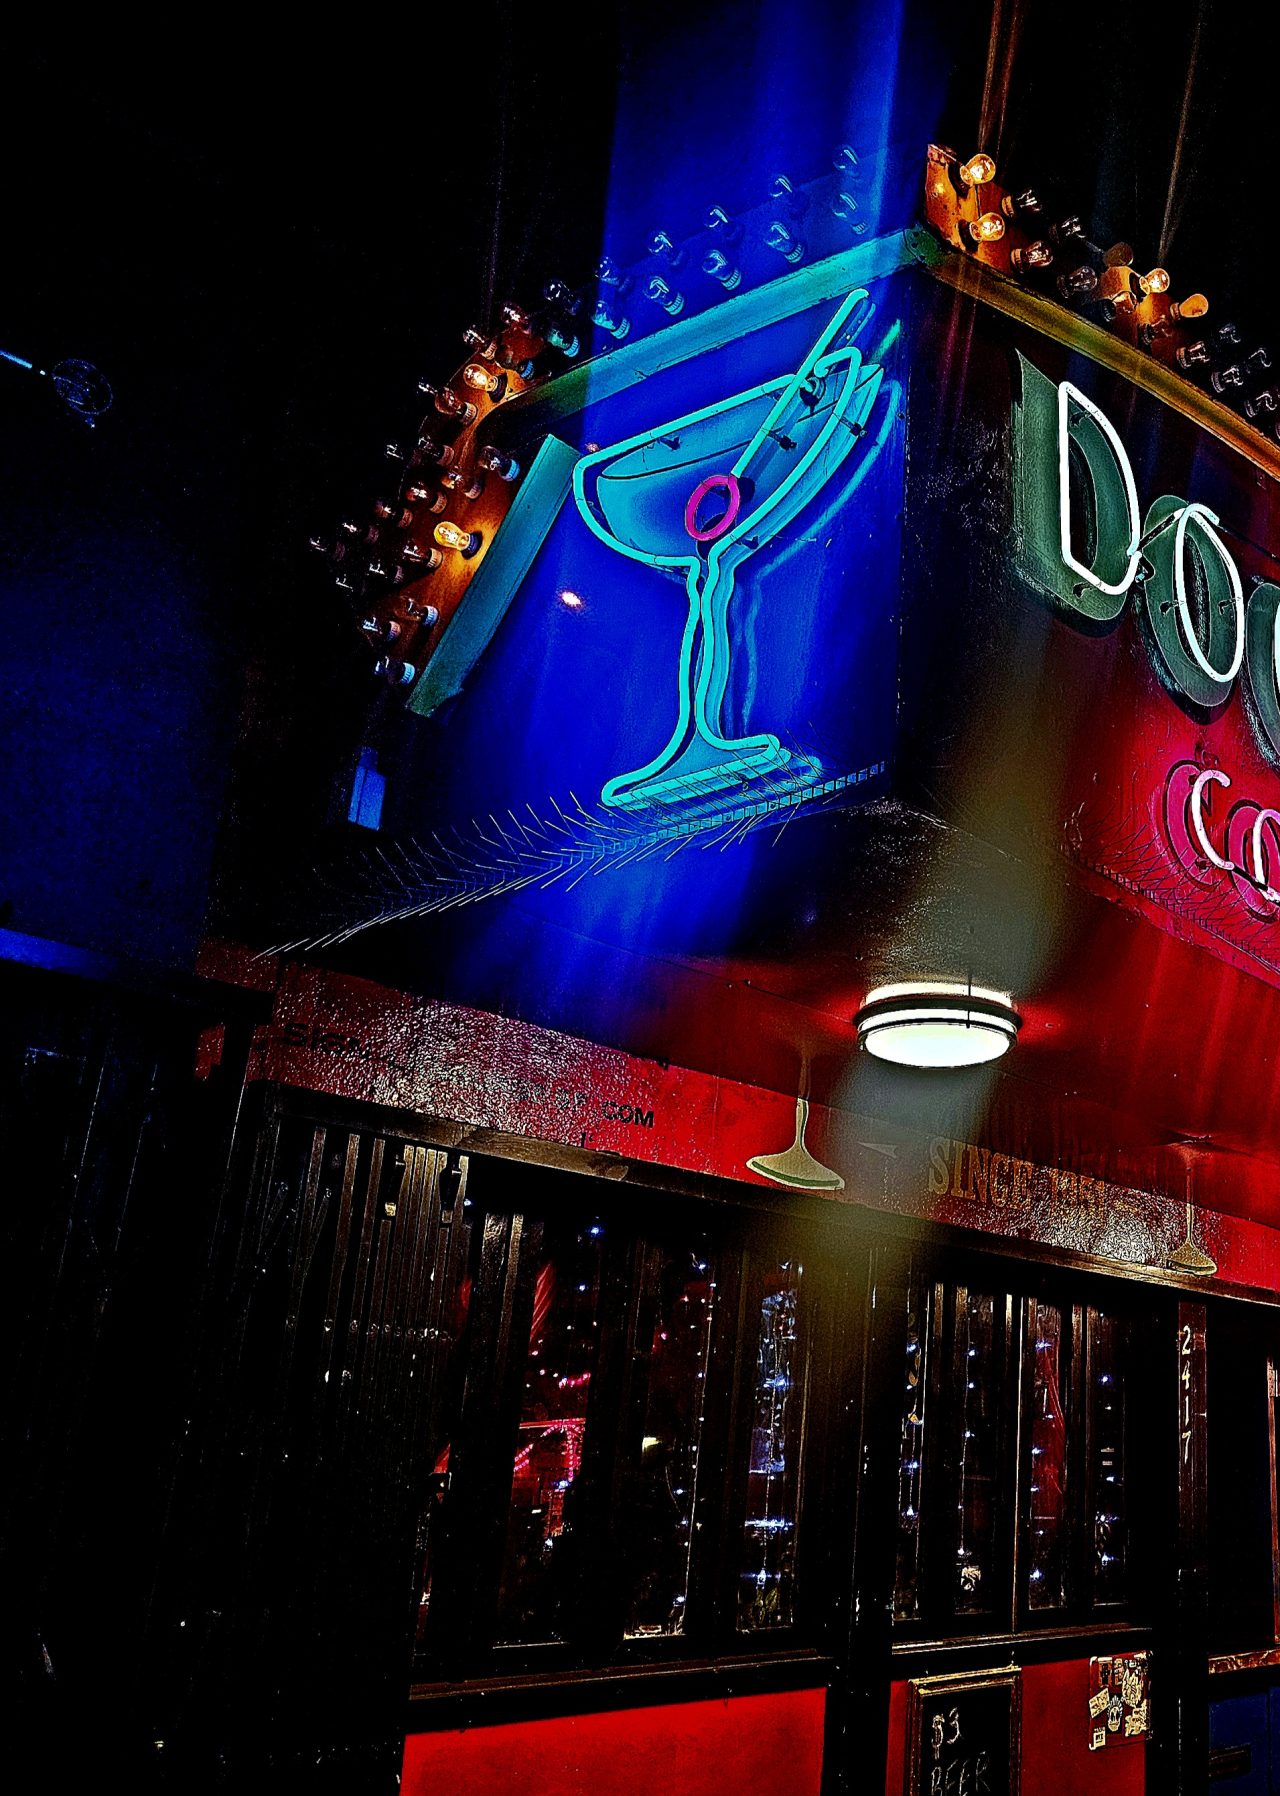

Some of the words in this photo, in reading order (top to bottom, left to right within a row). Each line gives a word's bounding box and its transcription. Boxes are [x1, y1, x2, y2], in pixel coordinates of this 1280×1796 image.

[928, 1136, 1034, 1208] SINCE
[1180, 1324, 1193, 1464] 2417
[930, 1751, 992, 1796] BEER
